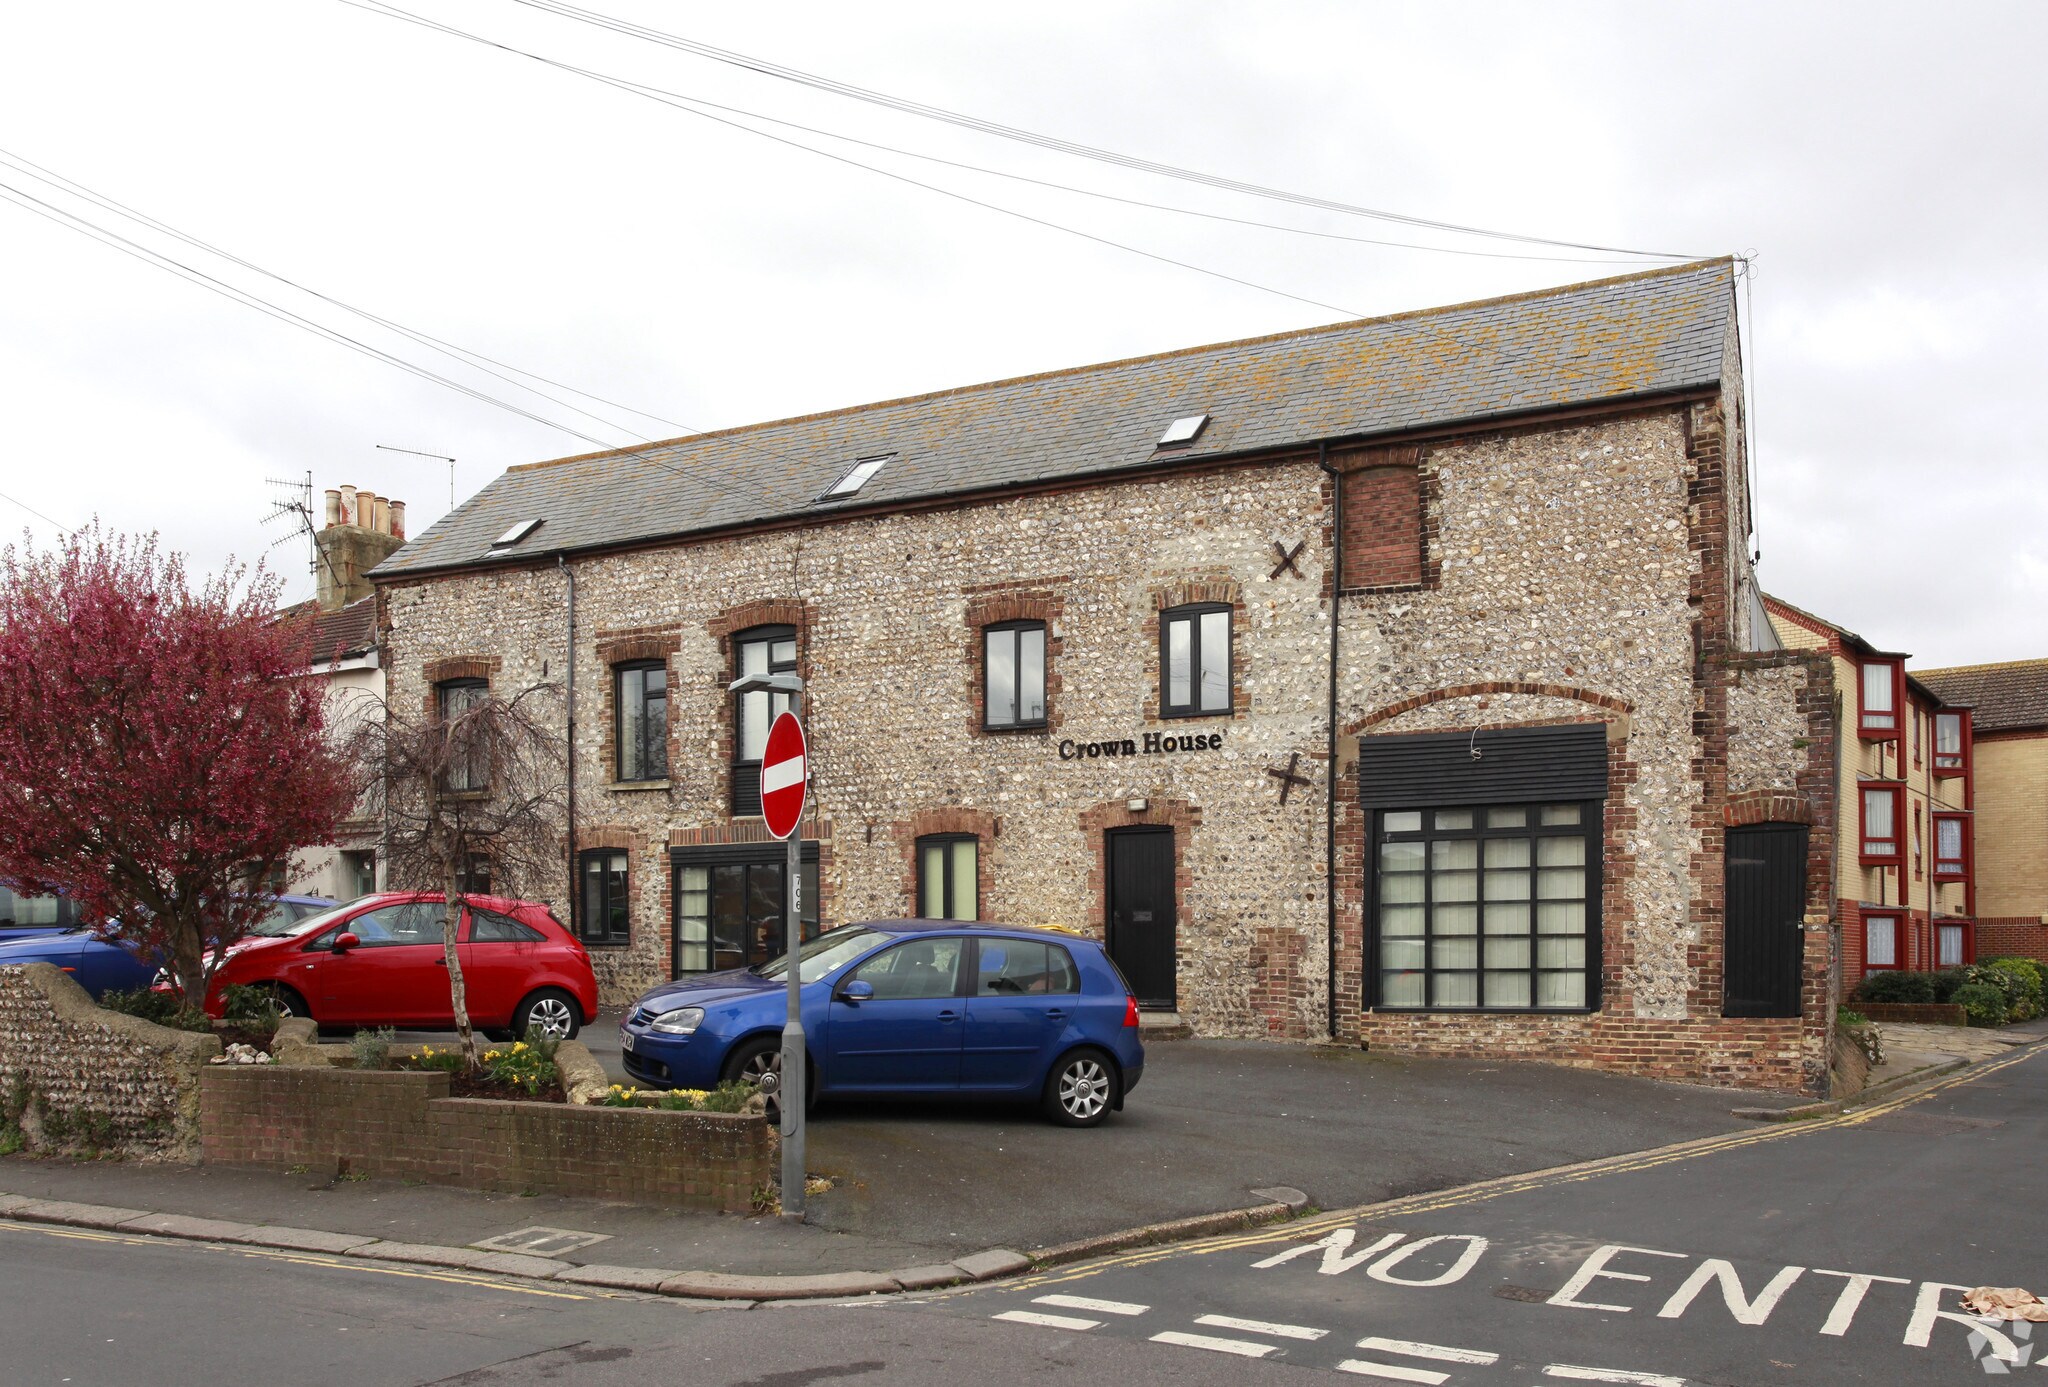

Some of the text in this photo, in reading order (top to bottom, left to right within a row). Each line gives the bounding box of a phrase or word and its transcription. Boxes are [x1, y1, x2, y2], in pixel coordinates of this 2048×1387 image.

[1058, 732, 1222, 761] Crown House
[1250, 1228, 2048, 1367] NO ENTR
